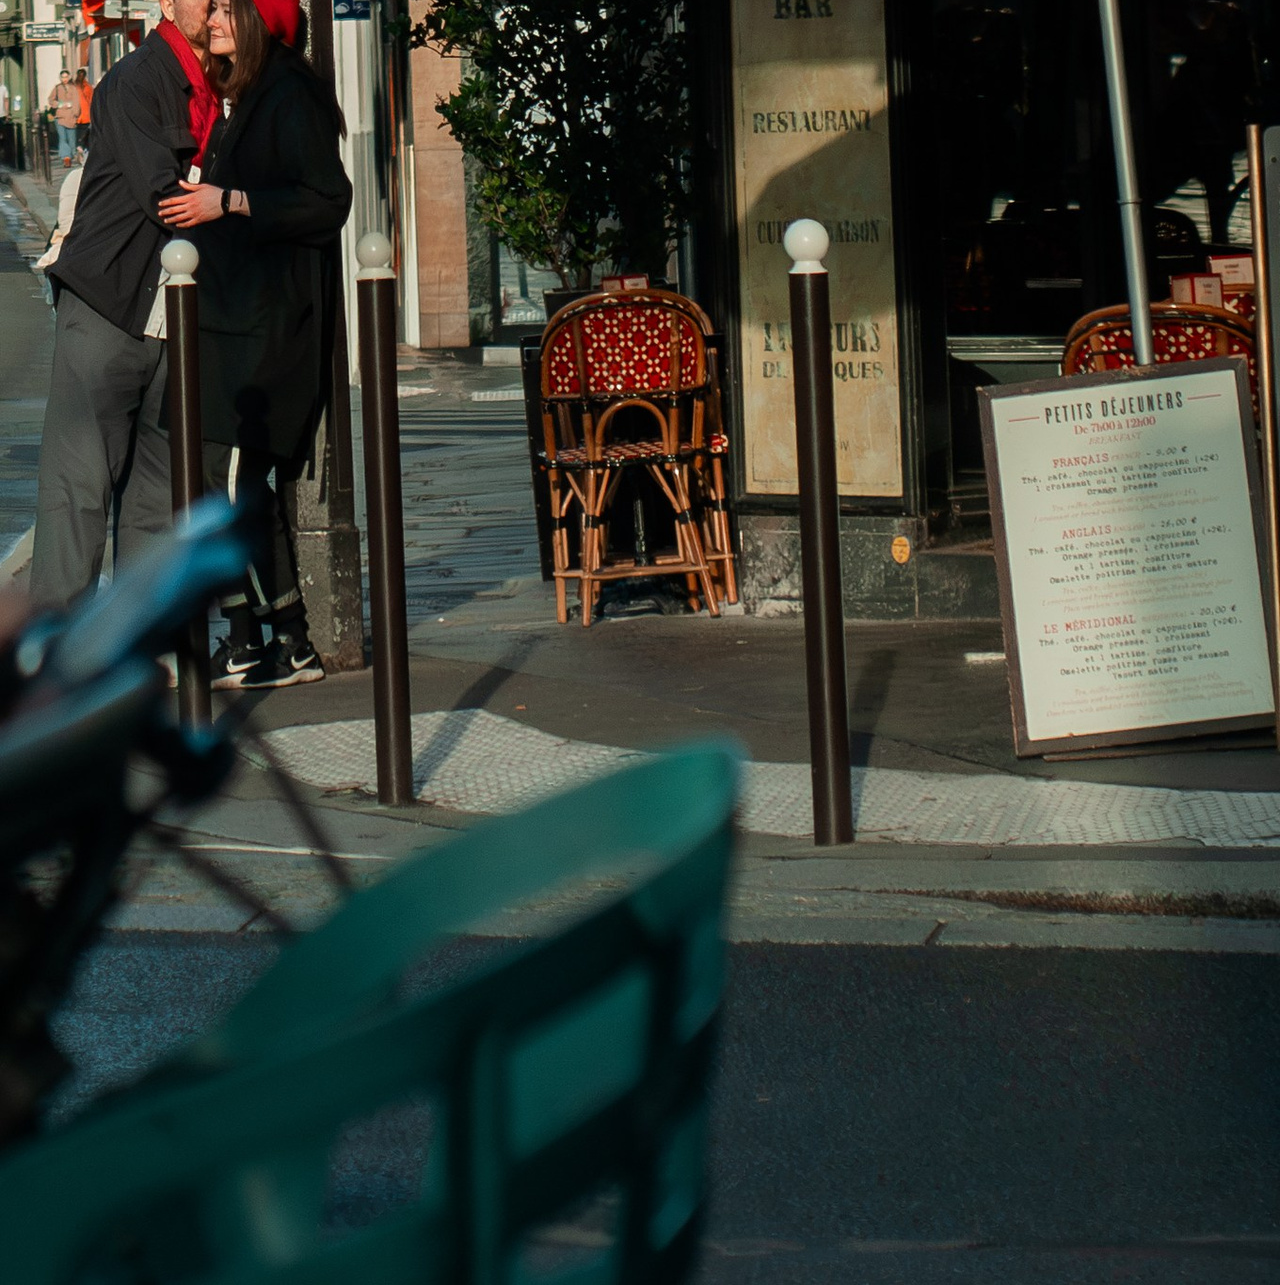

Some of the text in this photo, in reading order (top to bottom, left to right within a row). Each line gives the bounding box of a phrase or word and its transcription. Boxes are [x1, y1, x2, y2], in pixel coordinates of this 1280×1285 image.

[753, 109, 872, 135] RESTAURANT
[1045, 391, 1182, 424] PETITS DÉJEUNERS
[1074, 425, 1088, 435] De
[1091, 421, 1116, 432] 7h00
[1126, 416, 1156, 428] 12h00
[1053, 453, 1108, 468] FRANÇAIS
[1062, 525, 1111, 539] ANGLAIS
[1044, 624, 1058, 634] LE
[1065, 615, 1136, 631] MÉRIDIONAL
